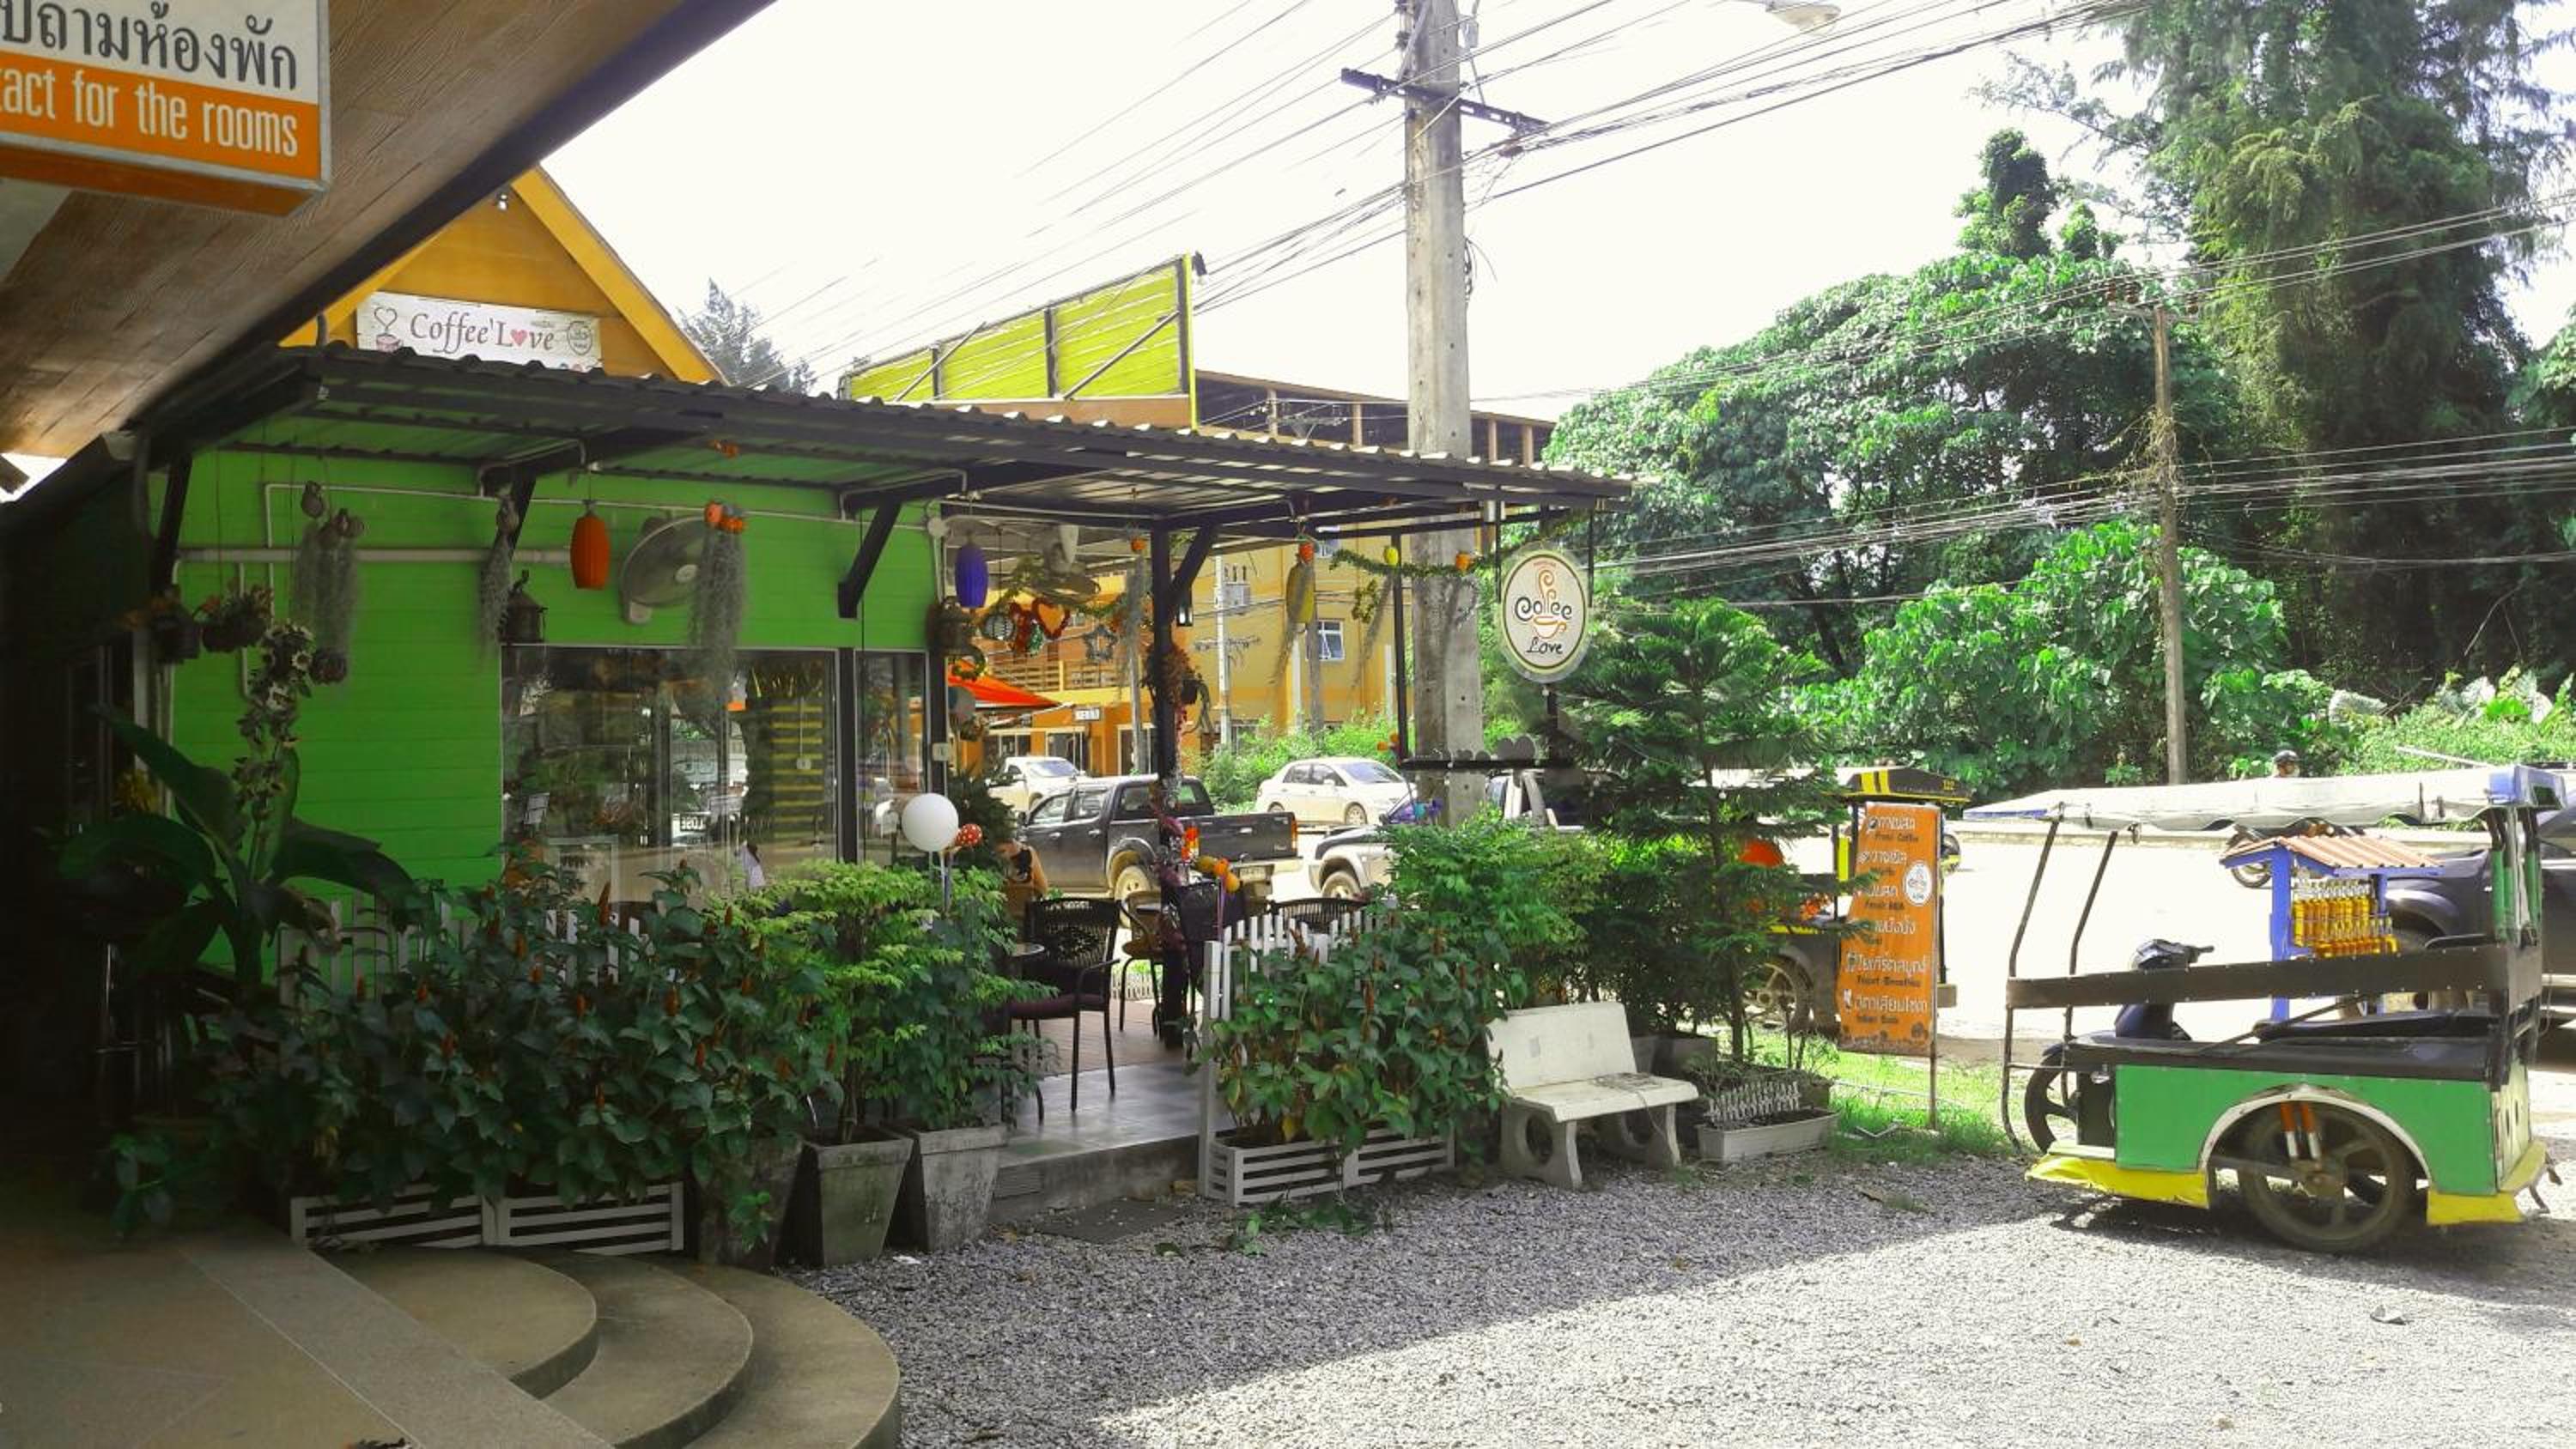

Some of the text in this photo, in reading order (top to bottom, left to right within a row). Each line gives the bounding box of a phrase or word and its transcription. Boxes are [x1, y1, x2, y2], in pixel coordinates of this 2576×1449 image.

[0, 68, 298, 157] act for the rooms
[1525, 636, 1564, 655] Love
